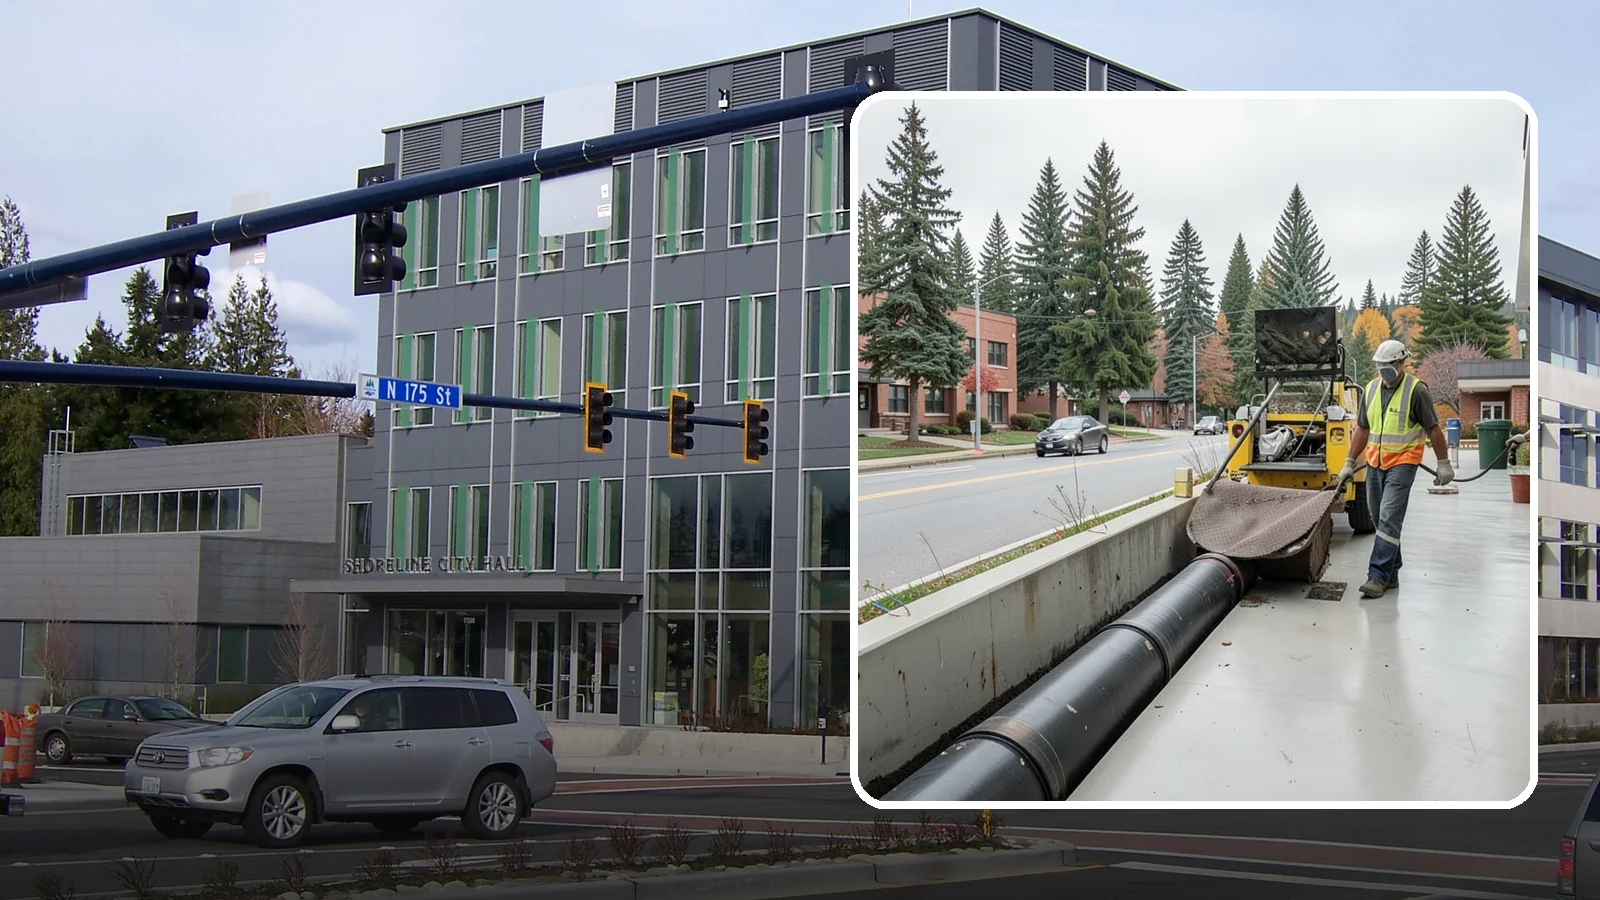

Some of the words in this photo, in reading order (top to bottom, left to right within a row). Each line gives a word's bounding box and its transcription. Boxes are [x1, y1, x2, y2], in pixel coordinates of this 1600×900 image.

[387, 380, 396, 399] N
[405, 382, 427, 403] 175
[436, 386, 451, 406] St
[344, 557, 431, 573] SHORELINE
[438, 556, 475, 571] CITY
[483, 555, 526, 571] HALL
